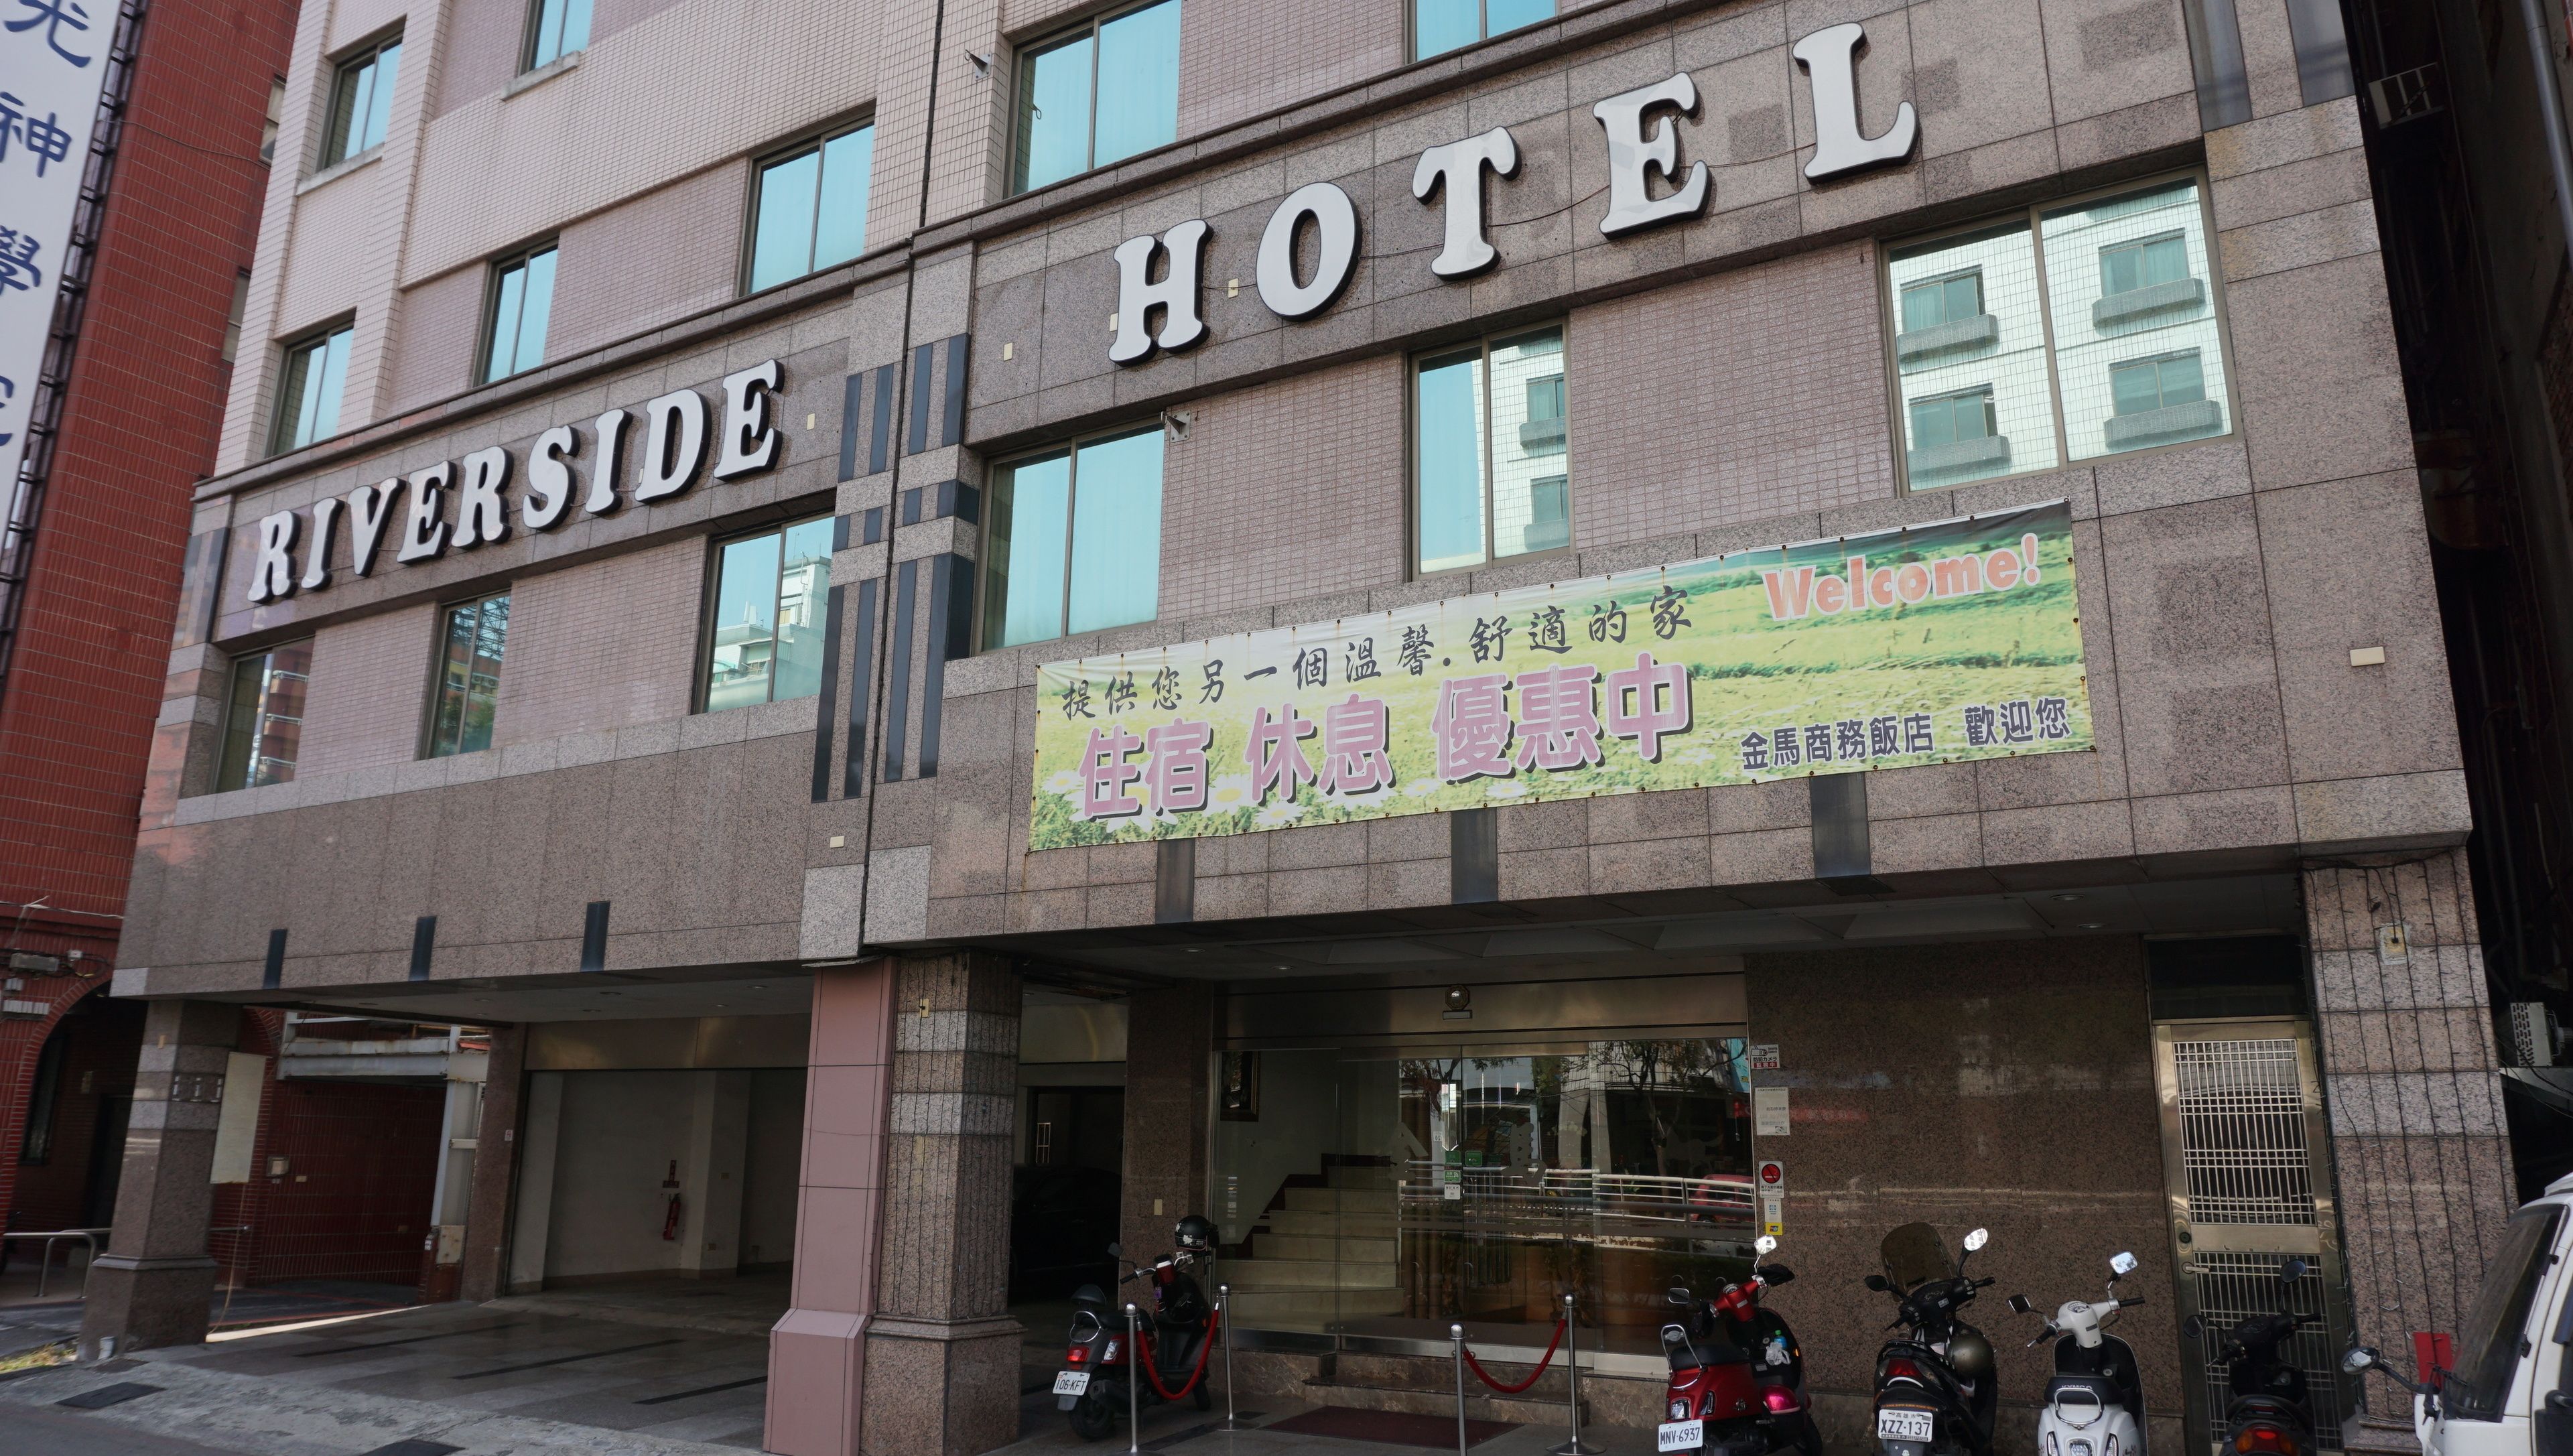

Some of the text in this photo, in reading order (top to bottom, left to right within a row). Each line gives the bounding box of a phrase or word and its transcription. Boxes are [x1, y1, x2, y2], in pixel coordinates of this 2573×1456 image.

[1108, 22, 1918, 367] HOTEL
[247, 358, 785, 605] RIVERSIDE
[1762, 533, 2039, 622] Welcome!
[1079, 651, 1694, 821] 住宿 休息 優惠中
[1740, 697, 2072, 771] 金馬商務飯店 歡迎您
